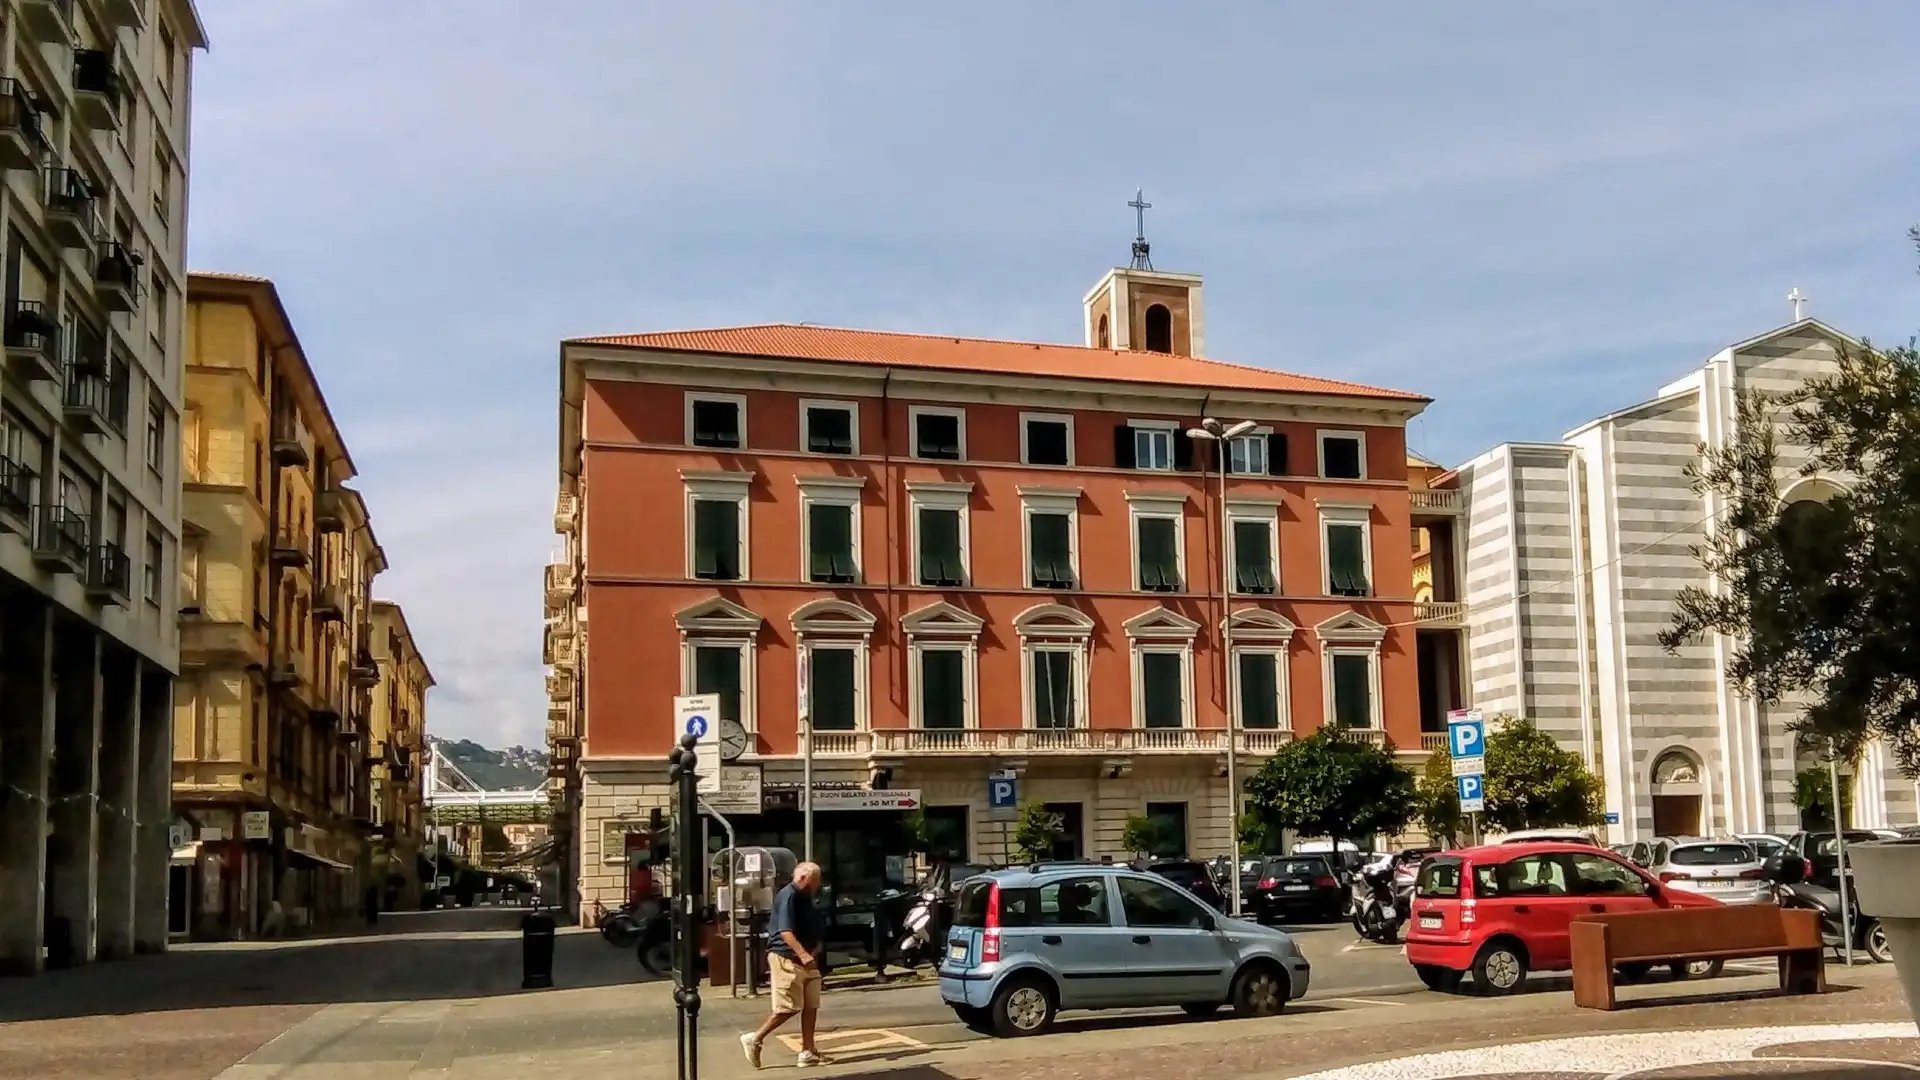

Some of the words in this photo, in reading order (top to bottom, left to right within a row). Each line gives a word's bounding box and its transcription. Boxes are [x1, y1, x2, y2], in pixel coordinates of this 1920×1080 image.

[1455, 725, 1478, 755] P
[841, 790, 867, 798] GELATO
[995, 782, 1012, 803] P
[1462, 778, 1478, 798] P
